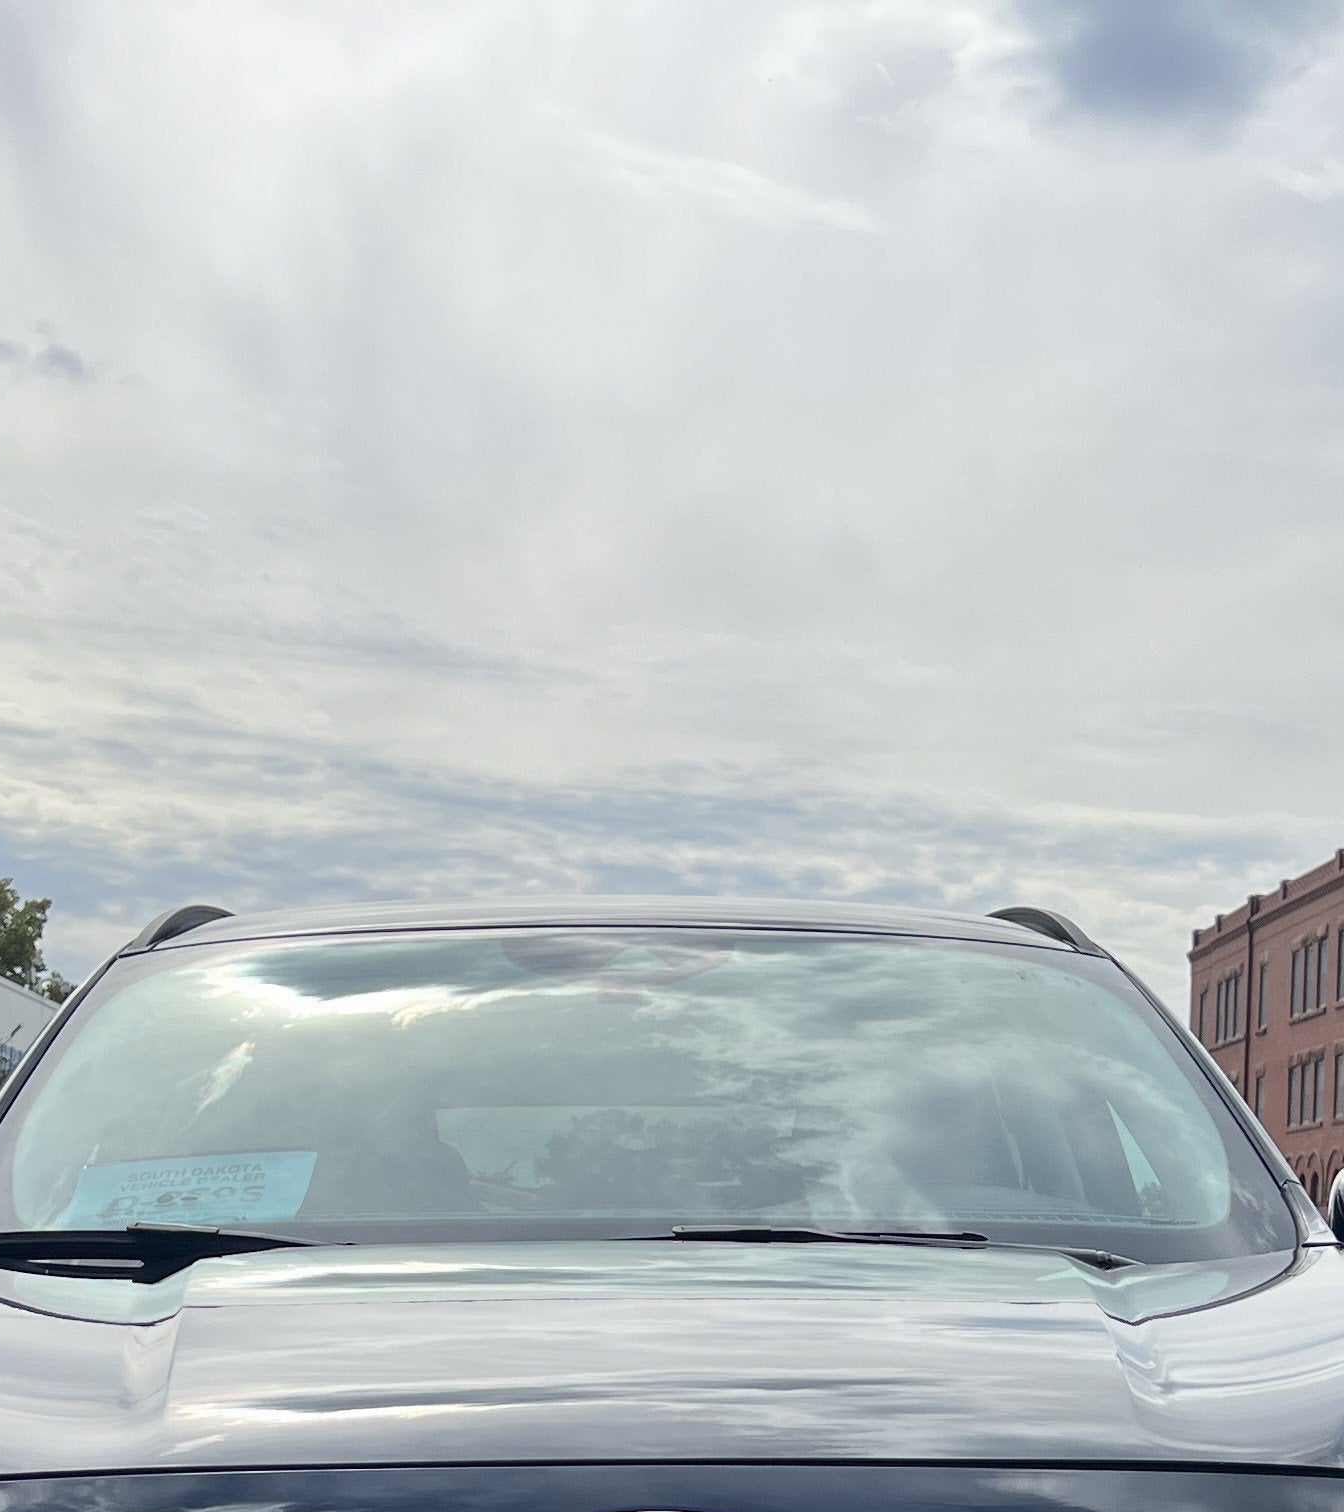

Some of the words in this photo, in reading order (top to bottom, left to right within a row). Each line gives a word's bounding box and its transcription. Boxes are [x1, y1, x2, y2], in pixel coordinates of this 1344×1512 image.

[121, 1177, 192, 1193] VEHICLE
[198, 1172, 266, 1185] DEALER
[127, 1169, 187, 1184] SOUTH
[191, 1163, 264, 1176] DAKOTA
